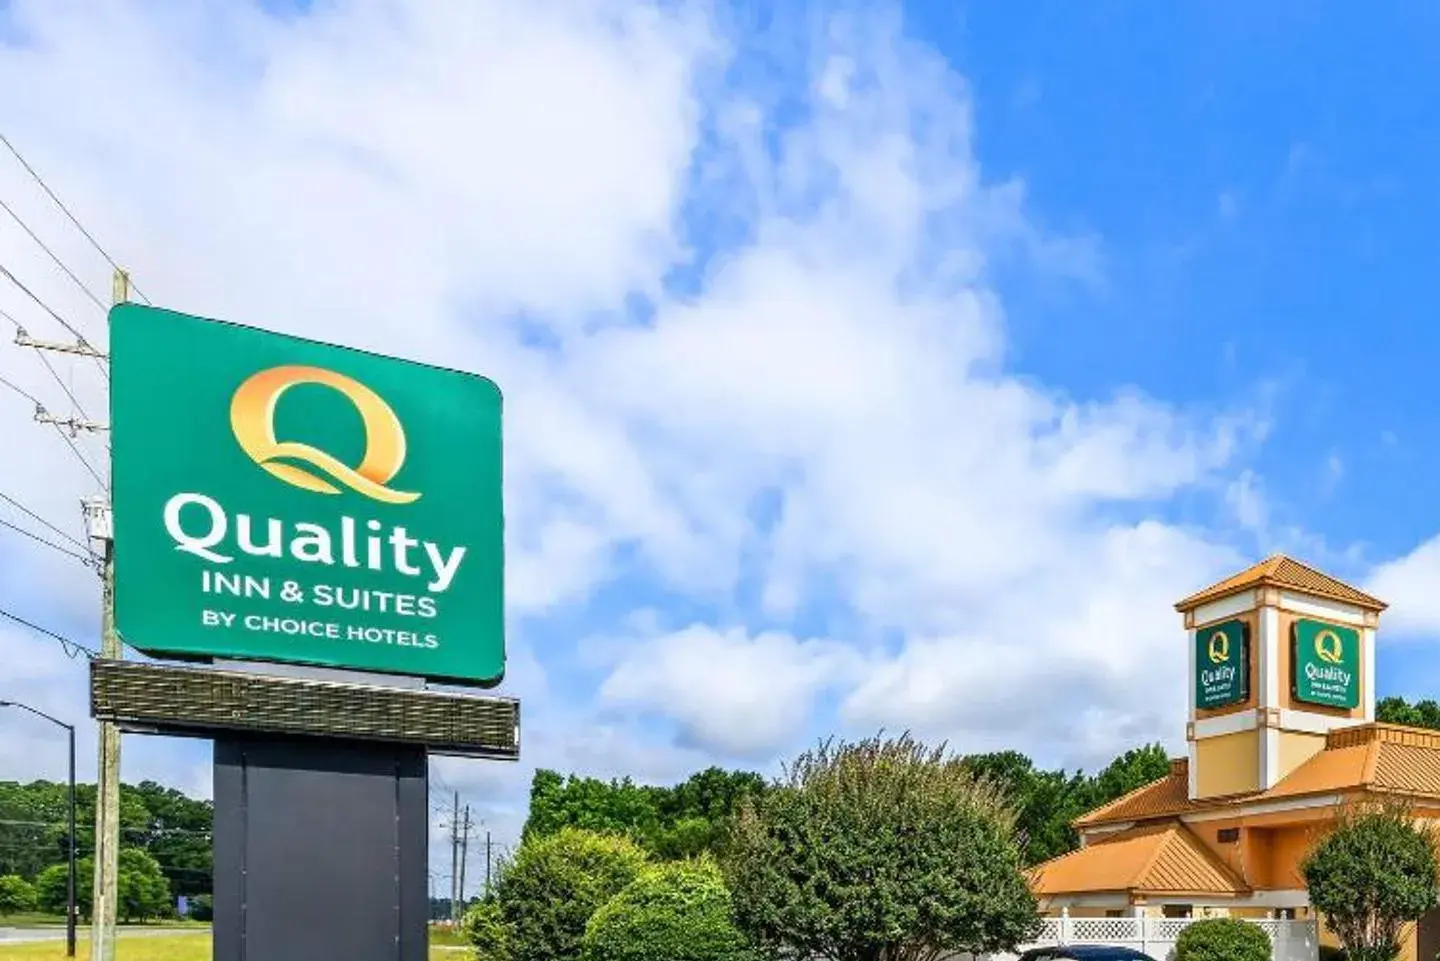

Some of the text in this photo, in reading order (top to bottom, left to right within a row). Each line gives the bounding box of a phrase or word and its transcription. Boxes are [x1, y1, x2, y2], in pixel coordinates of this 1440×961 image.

[229, 364, 423, 504] Q
[163, 492, 467, 593] Quality
[202, 570, 437, 618] INN & SUITES
[202, 609, 439, 649] BY CHOICE HOTELS
[1305, 661, 1351, 686] Quality
